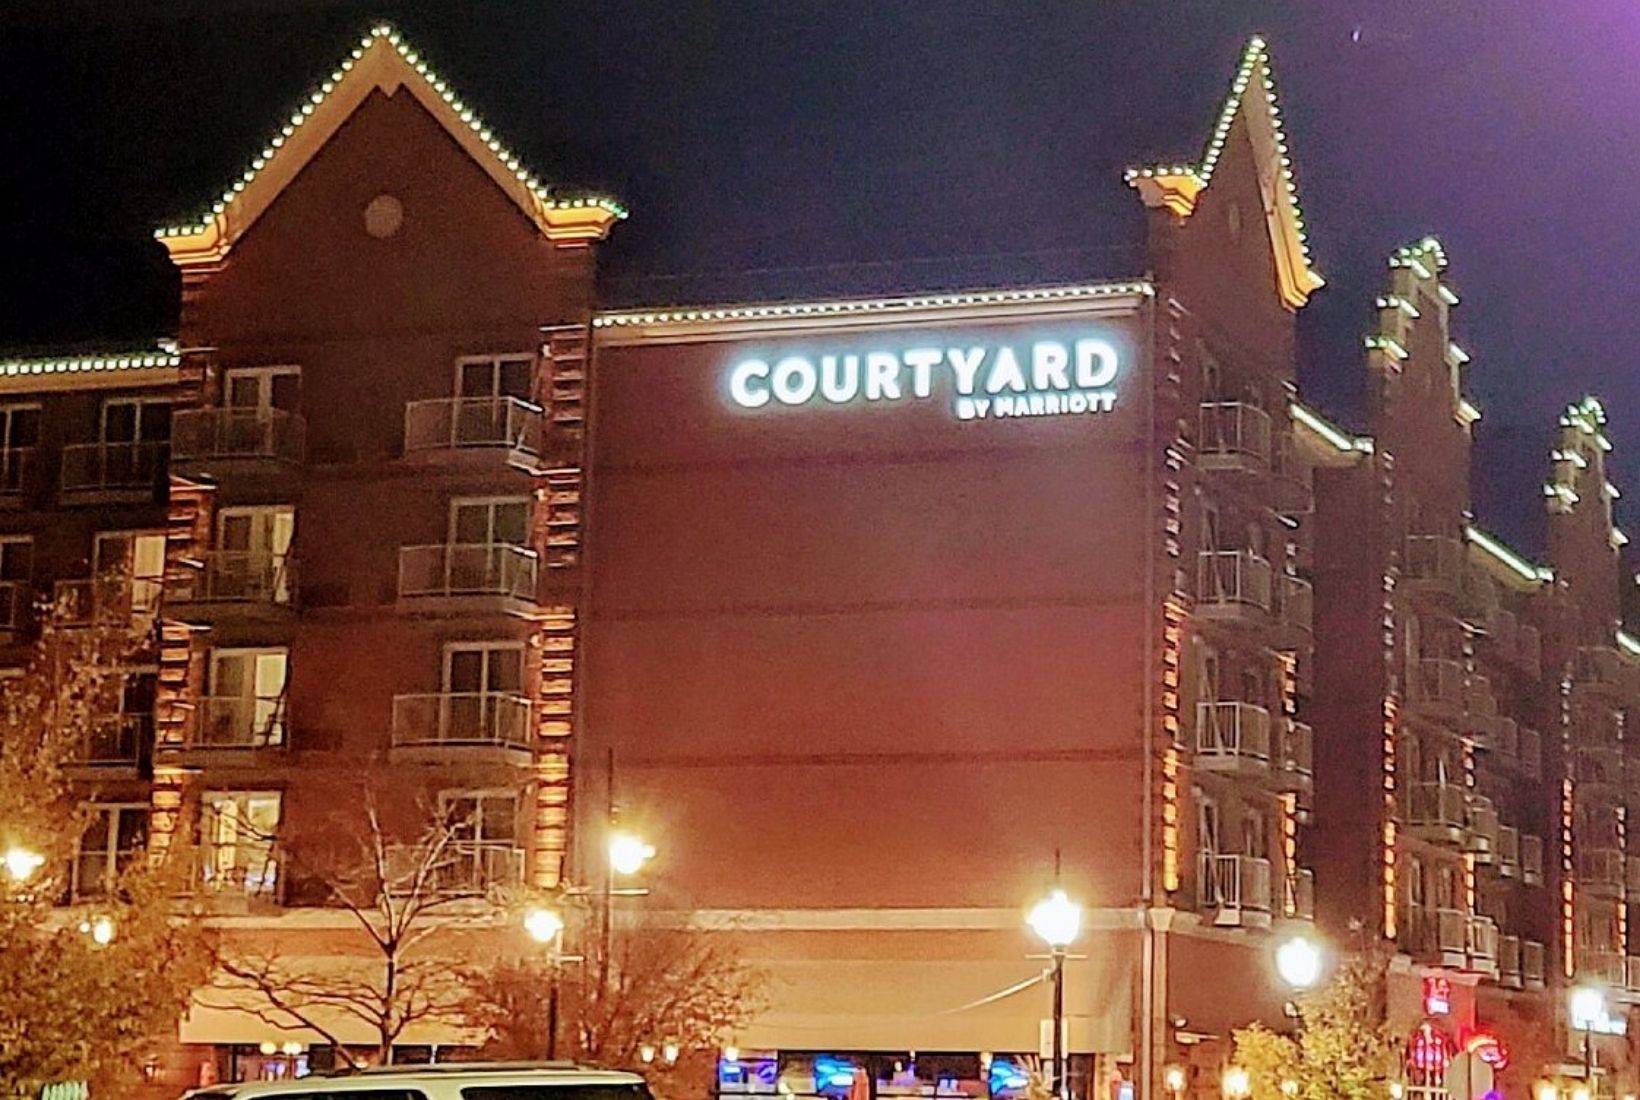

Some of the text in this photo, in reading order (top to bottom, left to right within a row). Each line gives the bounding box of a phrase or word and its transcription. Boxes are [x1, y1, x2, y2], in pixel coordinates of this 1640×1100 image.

[730, 339, 1118, 407] COURTYARD
[957, 391, 1118, 420] BY MARRIOTT
